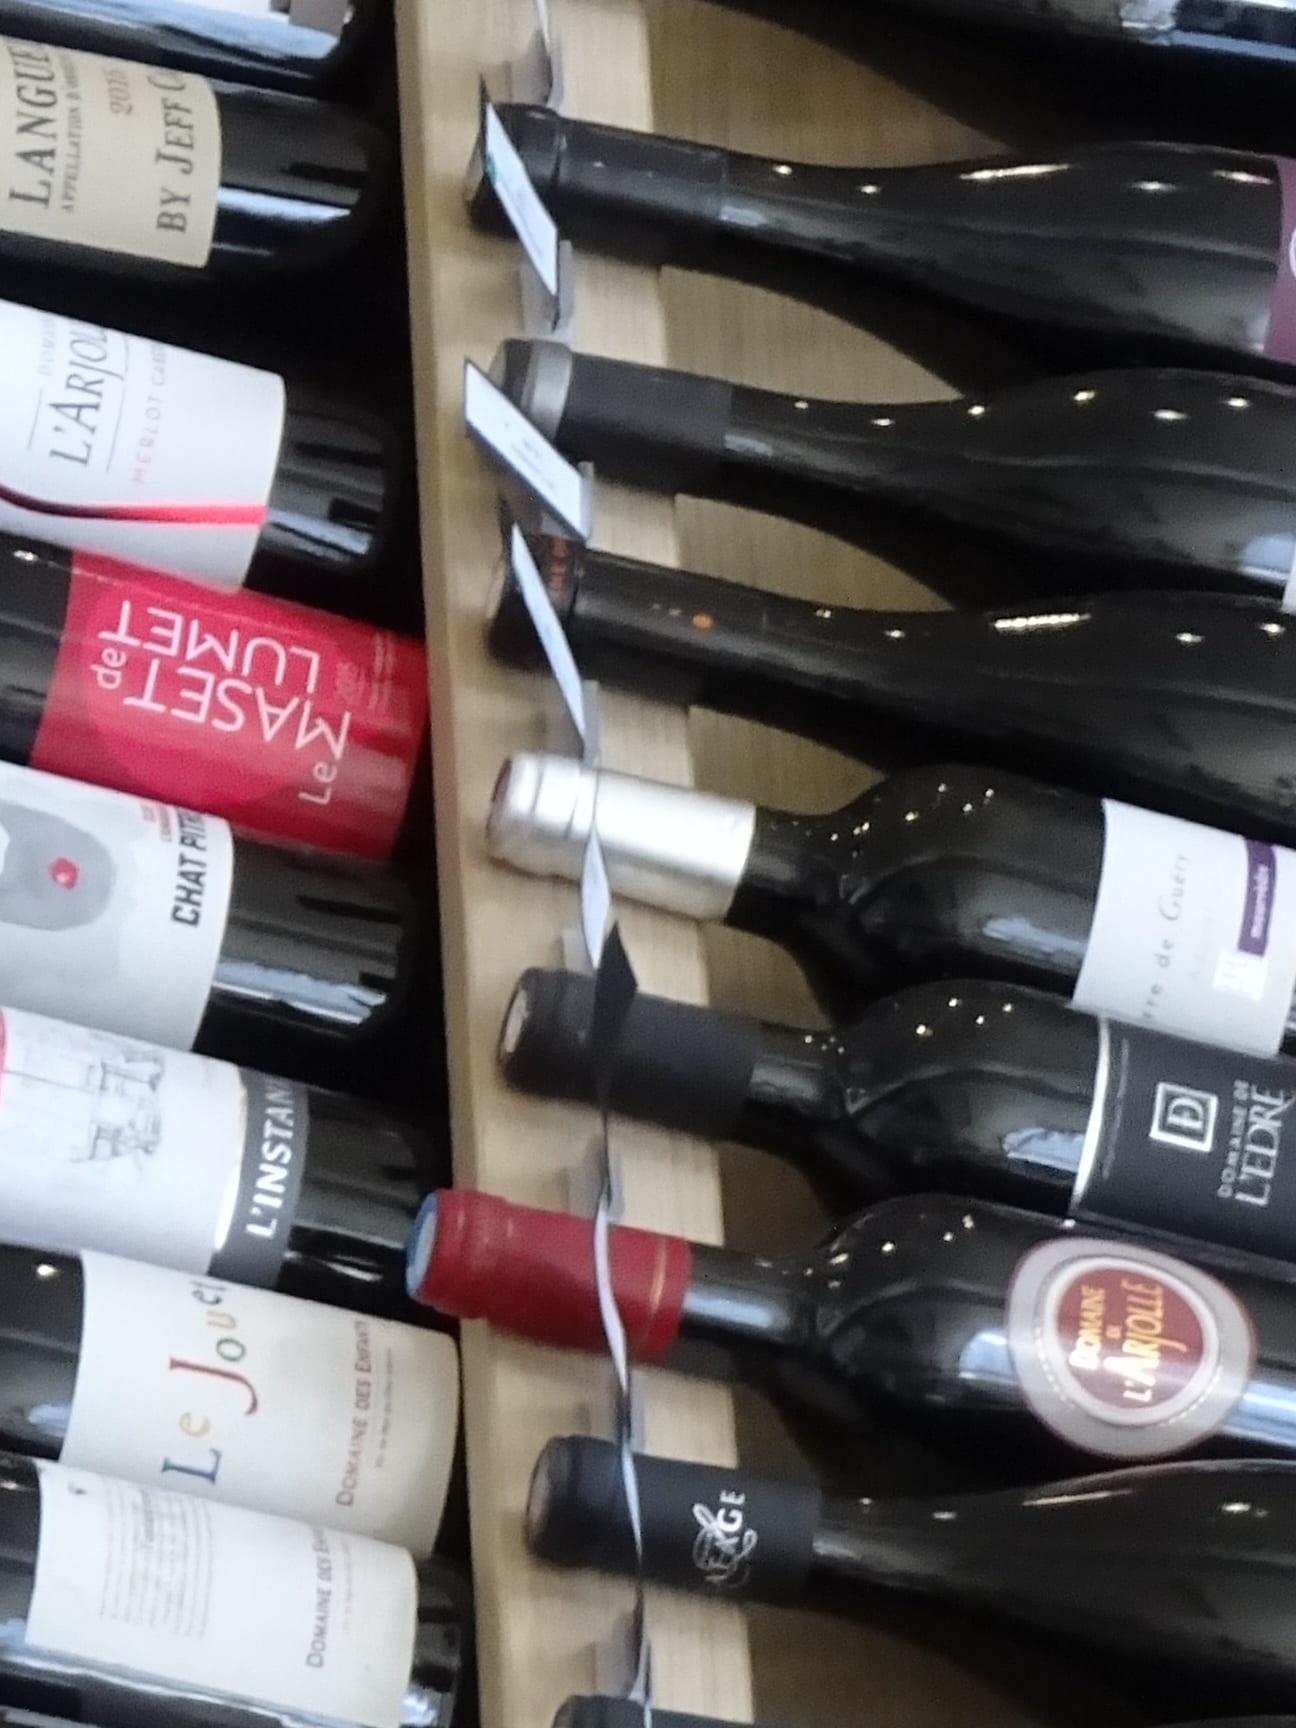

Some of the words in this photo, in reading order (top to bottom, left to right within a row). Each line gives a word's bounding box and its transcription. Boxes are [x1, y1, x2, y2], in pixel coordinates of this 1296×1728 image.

[156, 96, 196, 177] JEFF
[156, 195, 187, 235] BY
[131, 389, 165, 487] MERLOT
[89, 644, 127, 691] de
[97, 599, 322, 688] LUMET
[122, 676, 352, 761] MASET
[299, 762, 338, 808] Le
[170, 846, 207, 930] CHAT
[1156, 851, 1191, 929] Guéry
[1153, 945, 1171, 974] de
[1218, 1113, 1242, 1201] DOMAINE
[1069, 1282, 1106, 1374] DOMAINE
[1122, 1278, 1187, 1403] L'ARJOLLE
[334, 1412, 365, 1509] DOMAINE
[351, 1372, 372, 1410] DES
[311, 1548, 332, 1584] DES
[305, 1586, 330, 1670] DOMAINE
